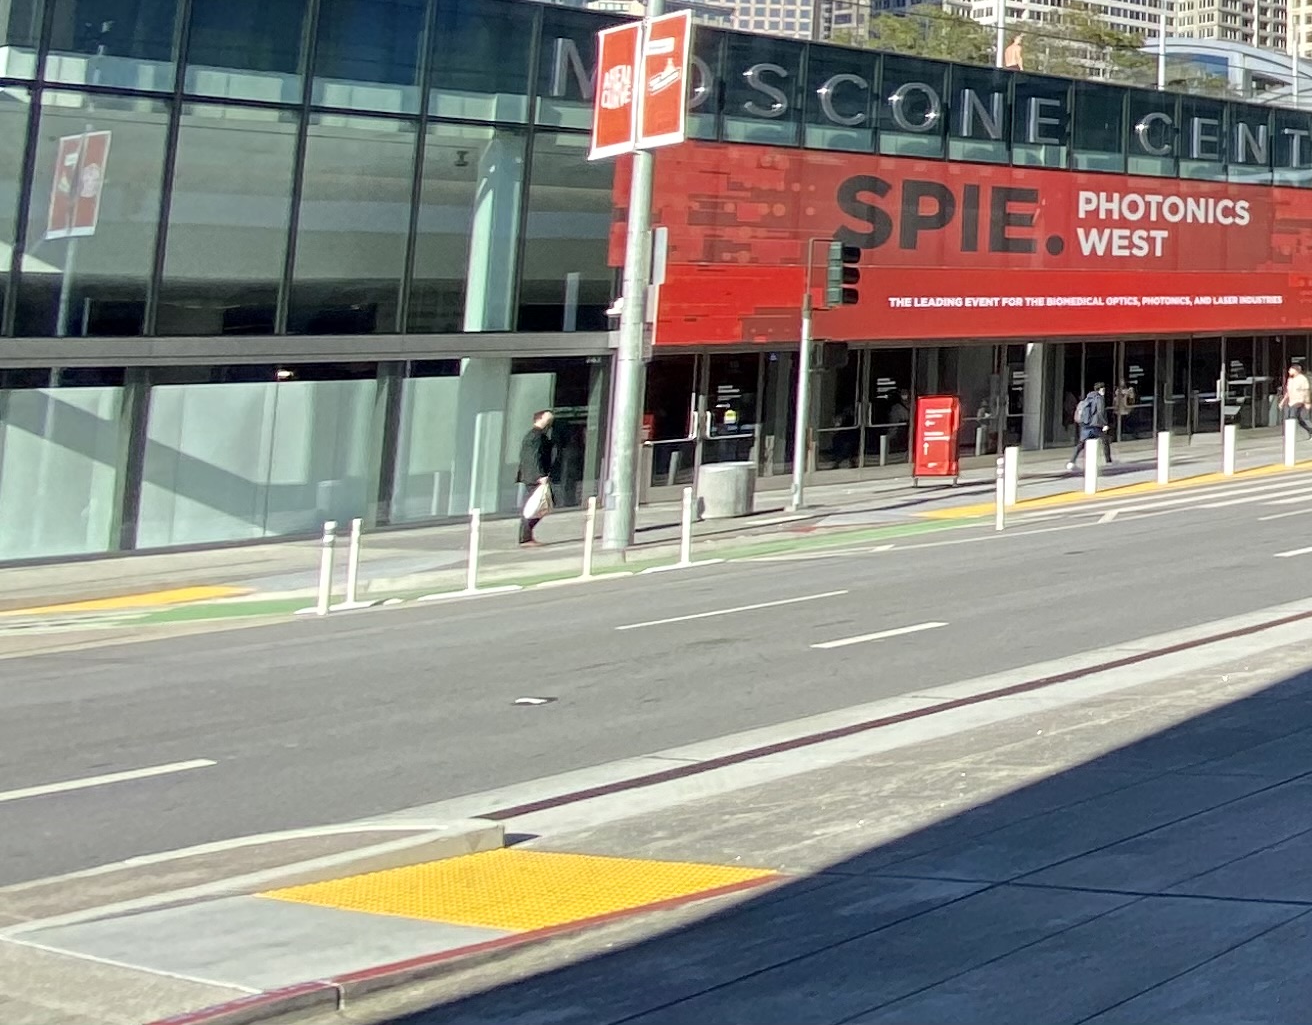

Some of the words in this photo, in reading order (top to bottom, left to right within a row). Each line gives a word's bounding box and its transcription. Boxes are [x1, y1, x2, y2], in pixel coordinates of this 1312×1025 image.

[1078, 190, 1251, 226] PHOTONICS
[1076, 227, 1168, 257] WEST
[888, 297, 912, 308] THE
[914, 297, 964, 307] LEADING
[965, 297, 1000, 307] EVENT
[1002, 297, 1024, 307] FOR
[1025, 297, 1045, 307] THE
[1046, 296, 1105, 307] BIOMEDICAL
[1105, 296, 1141, 308] OPTICS,
[1142, 296, 1193, 307] PHOTONICS,
[1193, 296, 1212, 305] AND
[1213, 296, 1238, 305] LASER
[1239, 295, 1283, 305] INDUSTRIES
